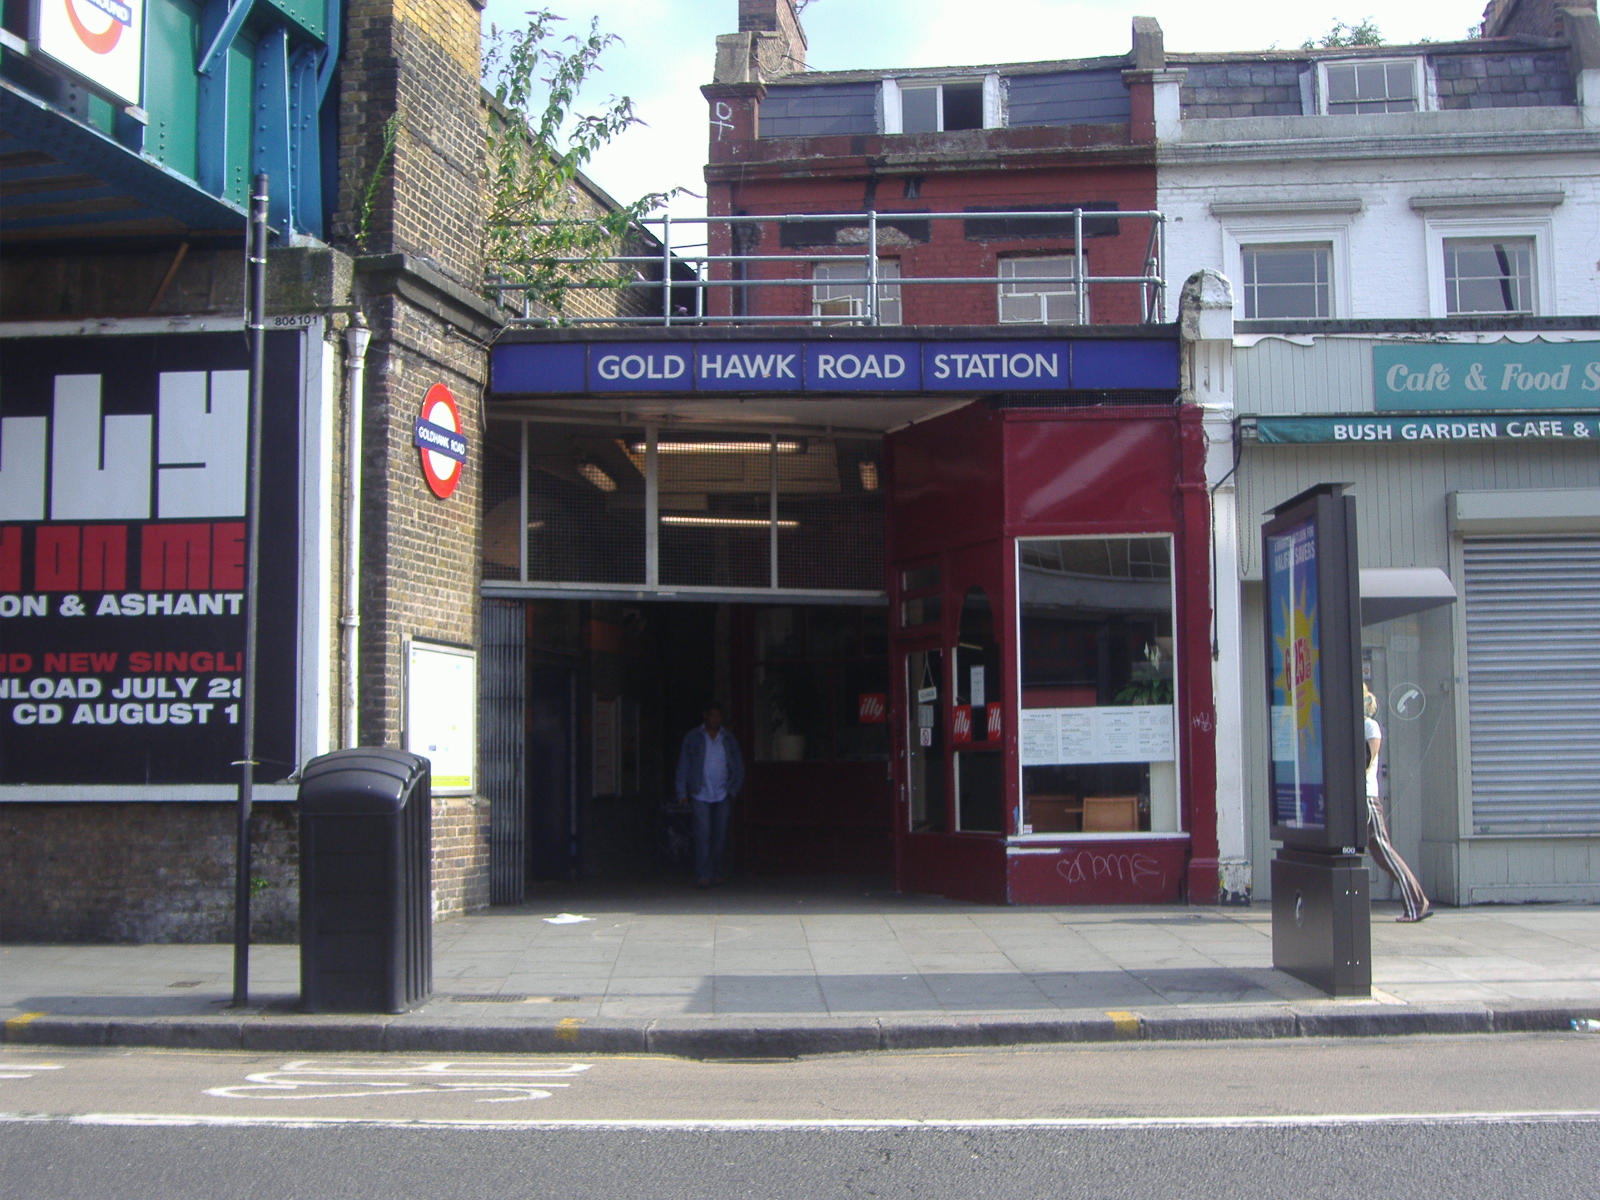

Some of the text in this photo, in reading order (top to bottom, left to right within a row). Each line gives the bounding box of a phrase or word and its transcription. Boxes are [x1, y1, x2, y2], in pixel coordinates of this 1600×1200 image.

[598, 353, 1058, 379] GOLD HAWK ROAD STATION
[1387, 363, 1450, 392] Café
[1465, 362, 1488, 391] &
[1501, 363, 1571, 391] Food
[1334, 424, 1392, 441] BUSH
[1401, 422, 1497, 440] GARDEN
[1506, 421, 1564, 437] CAFE
[1573, 422, 1590, 438] &
[450, 439, 465, 455] ROAD
[60, 595, 85, 616] &
[44, 653, 118, 672] NEW
[129, 652, 242, 672] SINGL
[111, 678, 198, 698] JULY
[13, 703, 62, 725] CD
[72, 703, 213, 724] AUGUST
[860, 697, 884, 720] illy
